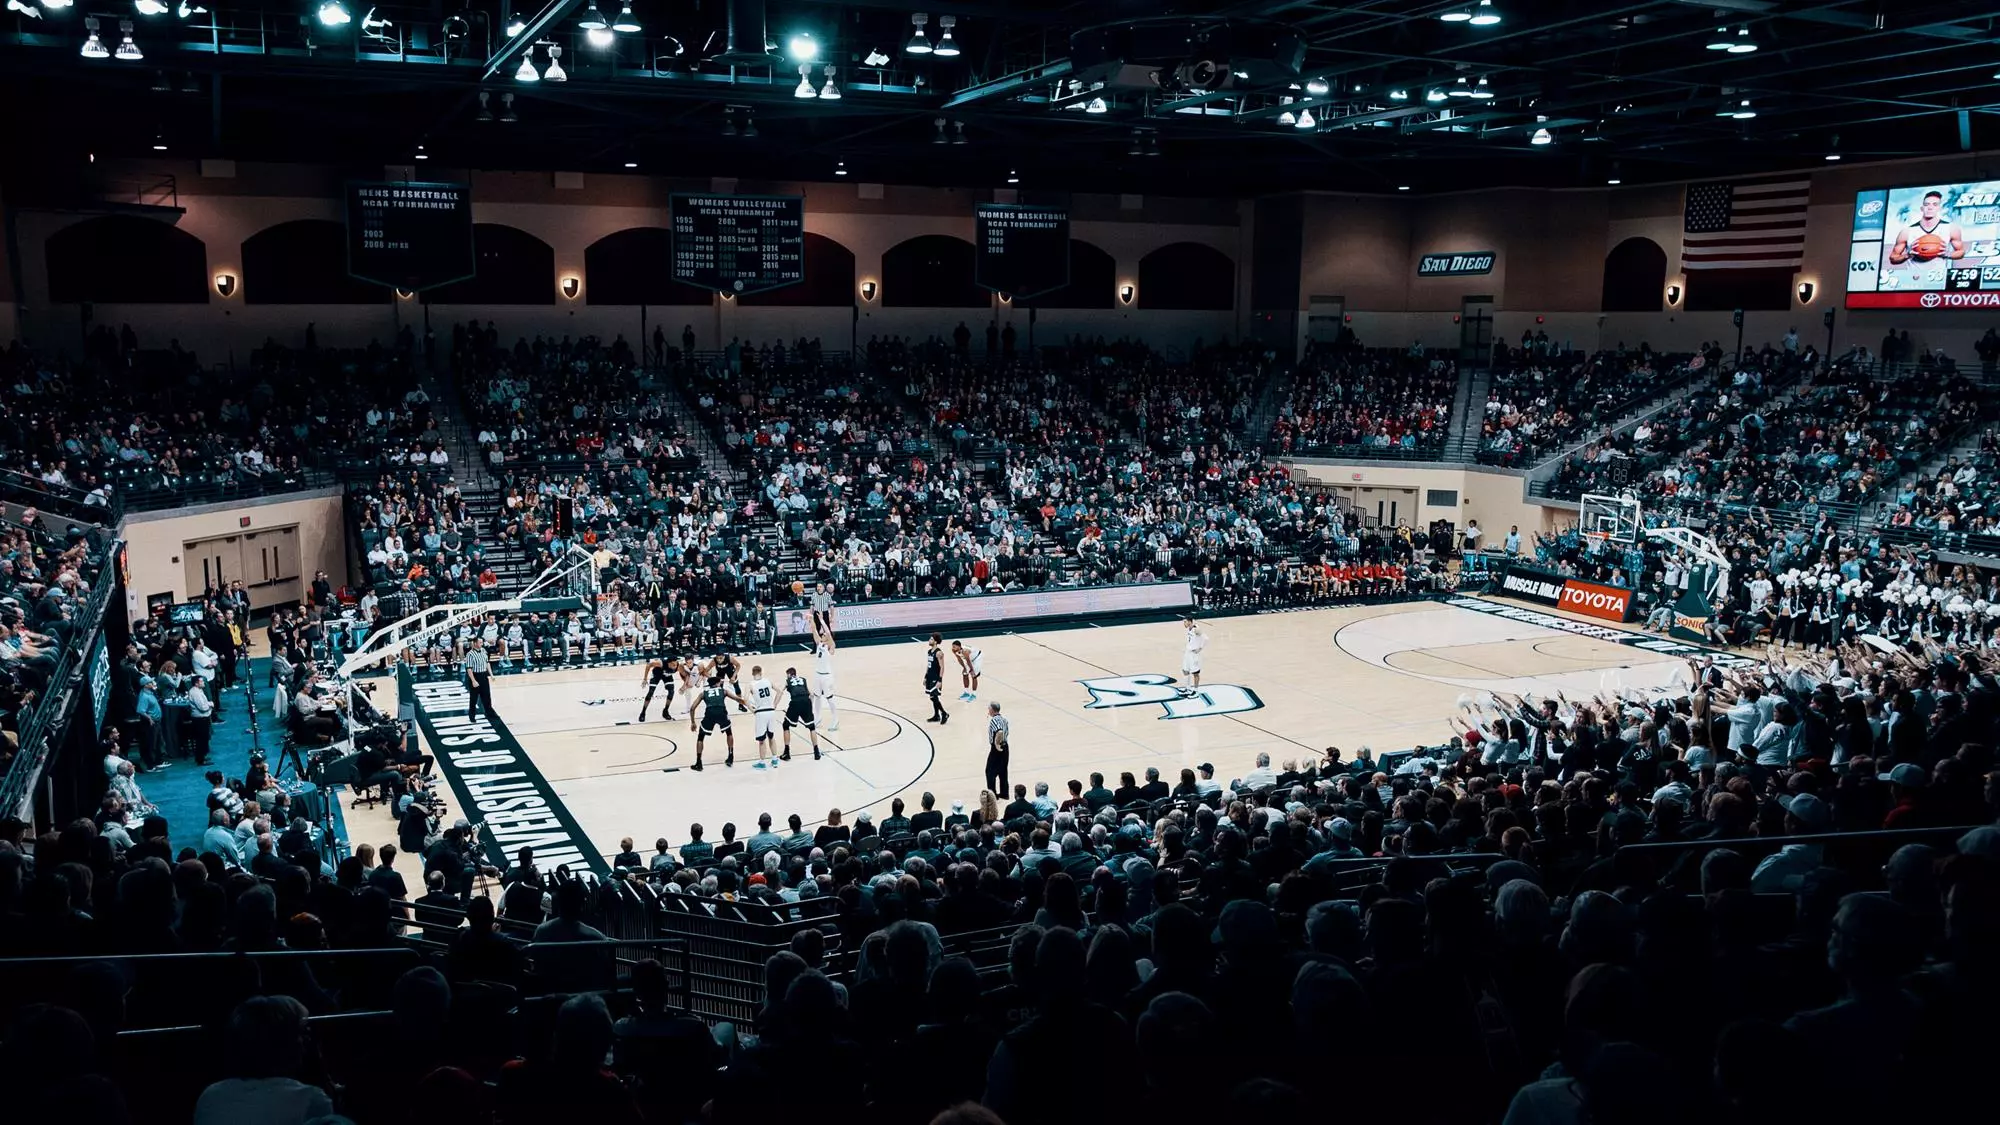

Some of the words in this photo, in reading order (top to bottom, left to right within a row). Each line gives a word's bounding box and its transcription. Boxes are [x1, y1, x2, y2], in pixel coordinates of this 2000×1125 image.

[358, 188, 389, 198] MENS
[393, 190, 460, 200] BASKETBALL
[362, 199, 389, 208] NCAA
[392, 200, 457, 210] TOURNAMENT
[688, 198, 730, 207] WOMENS
[733, 200, 787, 209] VOLLEYBALL
[724, 209, 776, 217] TOURNAMENT
[978, 211, 1015, 219] WOMENS
[1420, 257, 1450, 272] SAN
[1450, 256, 1491, 271] DIEGO
[1851, 260, 1875, 271] COX
[1950, 269, 1978, 280] 7:59
[1984, 268, 2000, 280] 52
[1943, 294, 2000, 306] TOYOTA
[1503, 574, 1539, 595] MUSCLE
[1537, 582, 1563, 600] MILK
[1563, 586, 1625, 613] TOYOTA
[837, 607, 865, 617] Isaiah
[406, 624, 444, 646] UNIVERSITY
[456, 612, 470, 623] SAN
[471, 604, 488, 617] DIEGO
[839, 617, 882, 629] PINEIRO
[1676, 616, 1704, 630] SONIC
[790, 677, 804, 687] 33
[707, 688, 721, 698] 21
[758, 687, 771, 698] 20
[429, 713, 501, 746] SAN
[447, 748, 517, 769] OF
